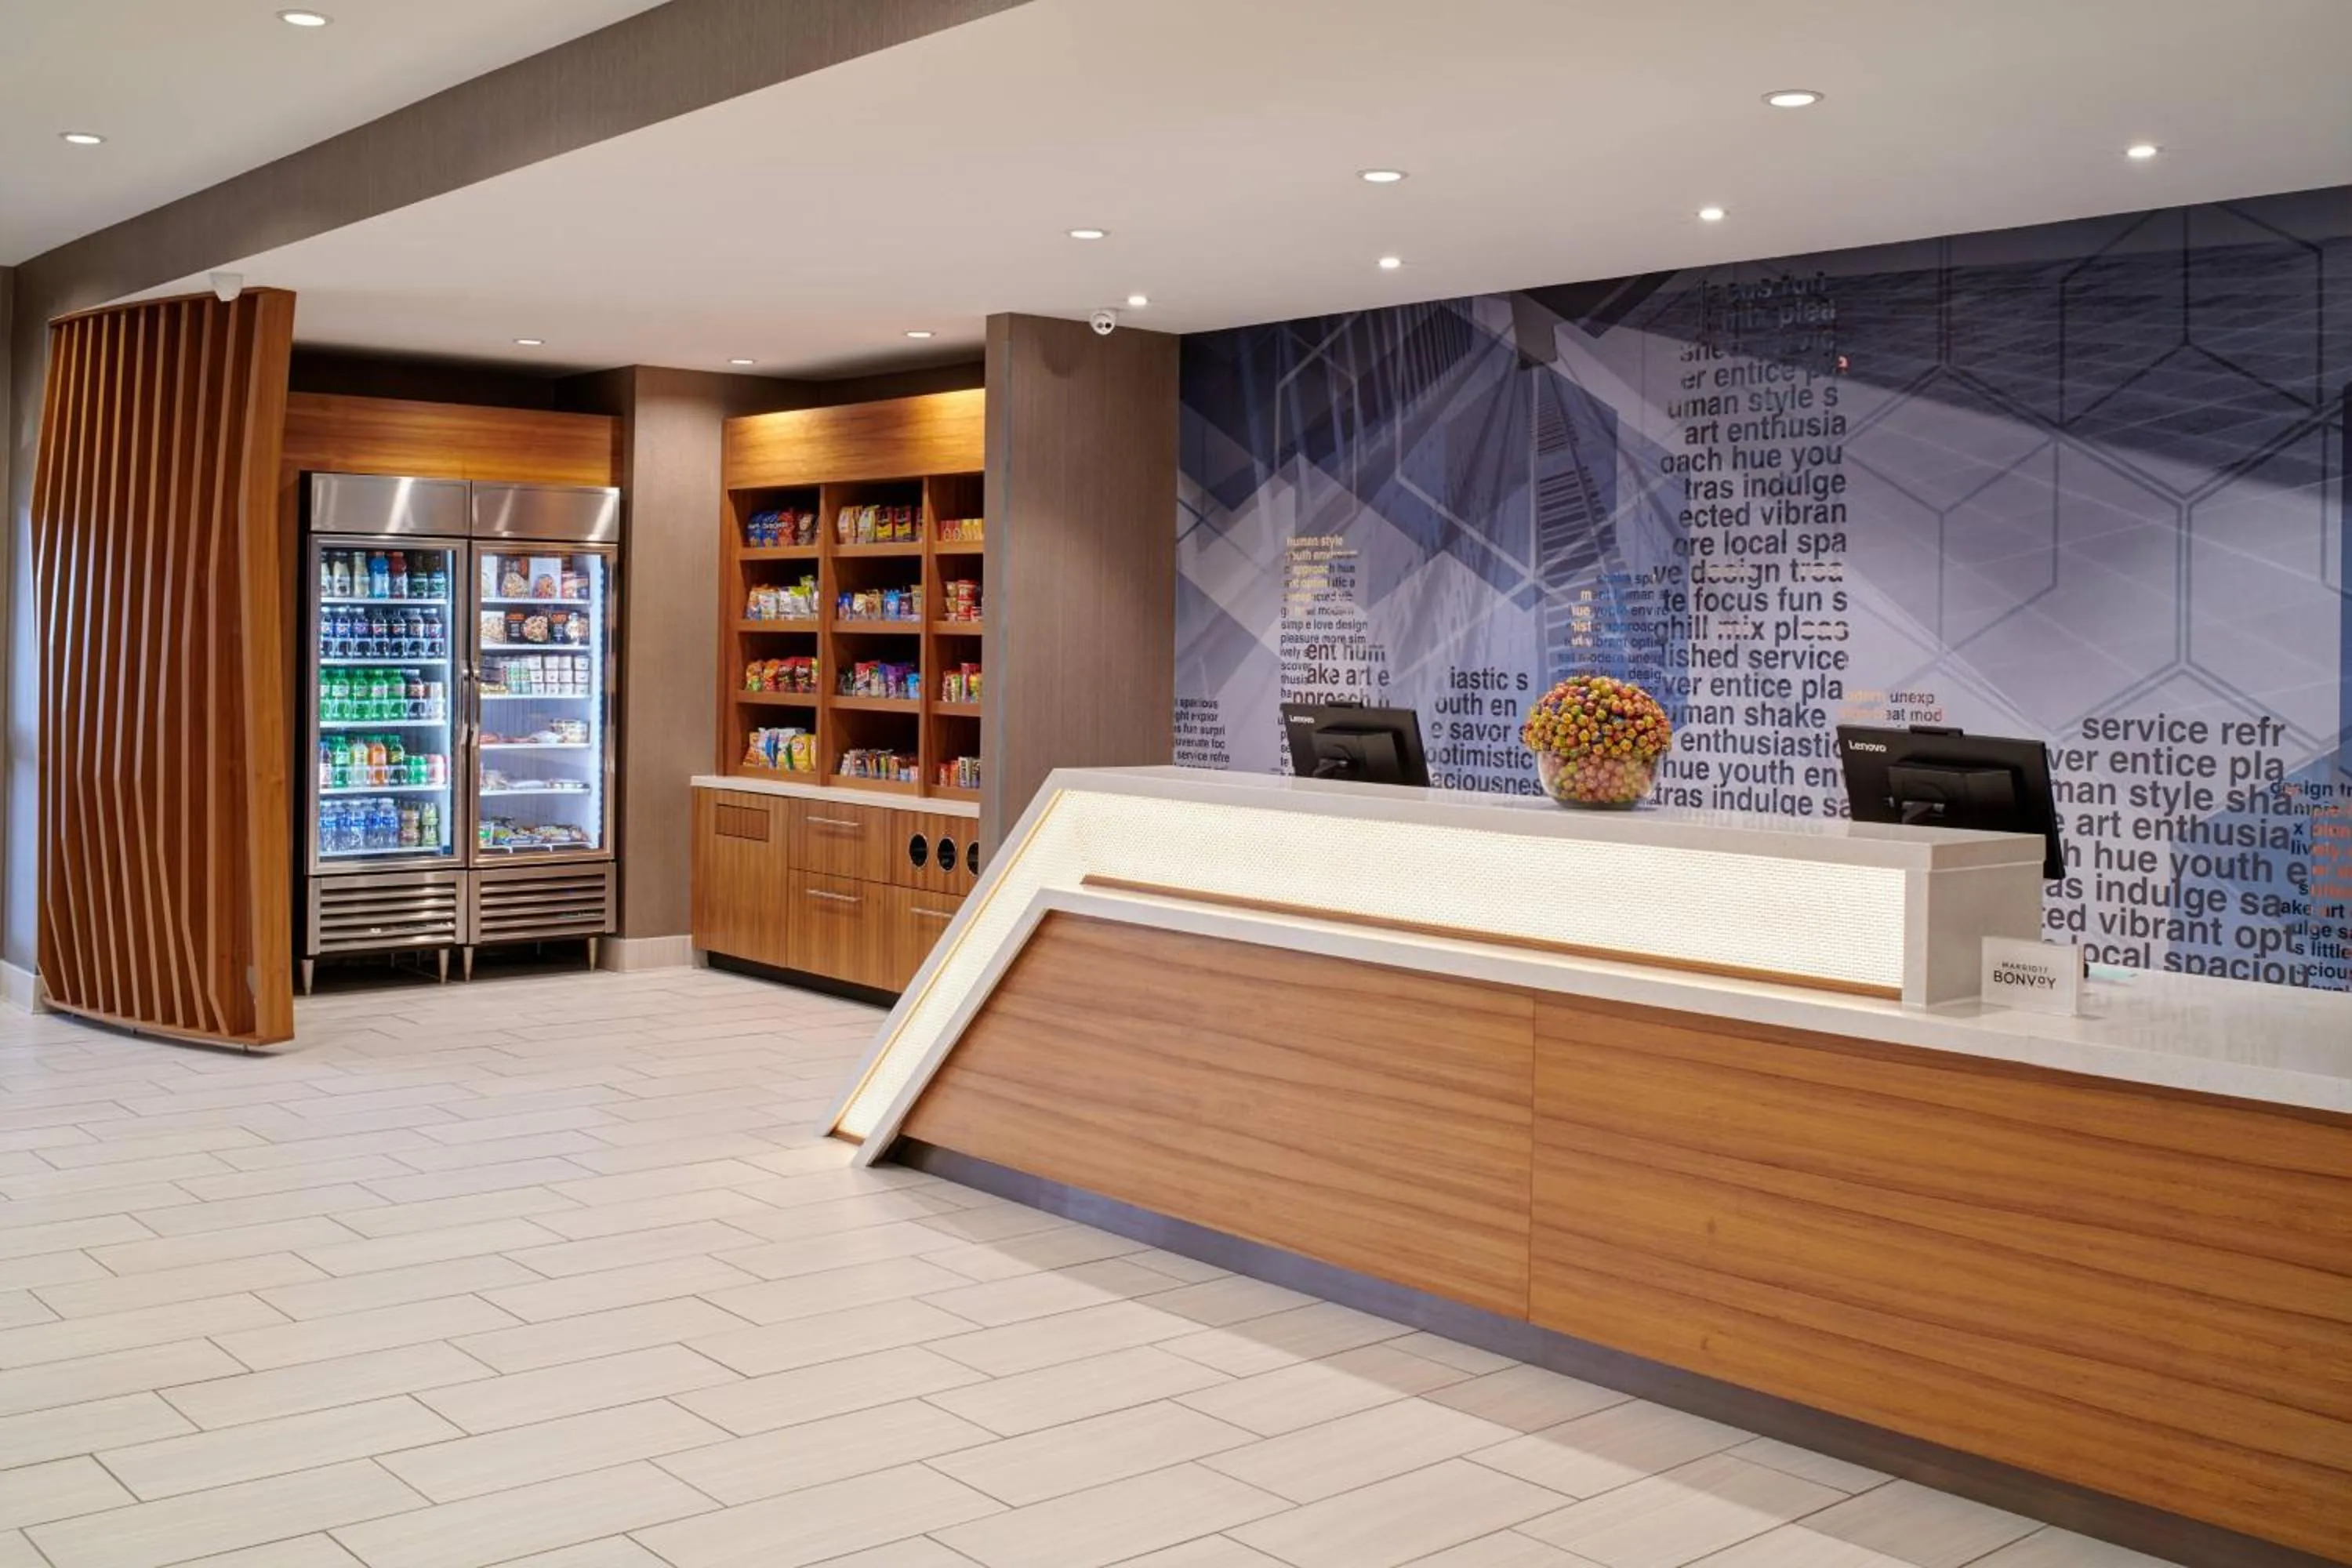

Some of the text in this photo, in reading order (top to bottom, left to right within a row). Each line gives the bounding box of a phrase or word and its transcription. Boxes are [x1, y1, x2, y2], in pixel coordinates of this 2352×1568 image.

[1715, 361, 1795, 387] entice
[1668, 383, 1838, 418] uman style s
[1685, 412, 1846, 445] art enthusia
[1733, 445, 1781, 470] hue
[1791, 445, 1842, 474] you
[1685, 468, 1846, 502] tras indulge
[1679, 499, 1846, 528] ected vibran
[1673, 528, 1846, 560] ore local spa
[1653, 565, 1682, 585] ve
[1664, 587, 1848, 612] te focus fun s
[1281, 633, 1319, 645] pleasure
[1348, 633, 1366, 644] sim
[1336, 619, 1368, 633] design
[1307, 644, 1338, 660] ent
[1748, 644, 1849, 669] service
[1307, 663, 1390, 686] ake art e
[1450, 666, 1528, 691] iastic s
[1661, 674, 1702, 695] ver
[1710, 672, 1791, 697] entice
[1802, 673, 1843, 706] pla
[1889, 691, 1935, 707] unexp
[1289, 715, 1315, 724] Lenovo
[1491, 699, 1517, 717] en
[1744, 703, 1827, 729] shake
[1910, 710, 1942, 722] mod
[2082, 713, 2285, 746] service refr
[1848, 739, 1887, 753] Lenovo
[1663, 752, 1710, 780] hue
[1719, 758, 1795, 787] youth
[2110, 746, 2216, 778] entice
[2230, 750, 2283, 786] pla
[1654, 783, 1703, 809] tras
[1712, 786, 1813, 817] indulge
[2129, 781, 2212, 817] style
[2226, 786, 2292, 815] sha
[2076, 811, 2121, 838] art
[2132, 814, 2289, 851] enthusia
[2063, 839, 2081, 867] h
[2095, 840, 2158, 873] hue
[2170, 852, 2273, 887] youth
[2286, 862, 2307, 884] e
[2096, 873, 2227, 918] indulge
[2240, 892, 2282, 918] sa
[2099, 907, 2222, 946] vibrant
[2236, 921, 2296, 958] opt
[1994, 970, 2056, 989] BONVOY
[2002, 961, 2049, 974] MARRIOTT
[2164, 951, 2309, 988] spaciou
